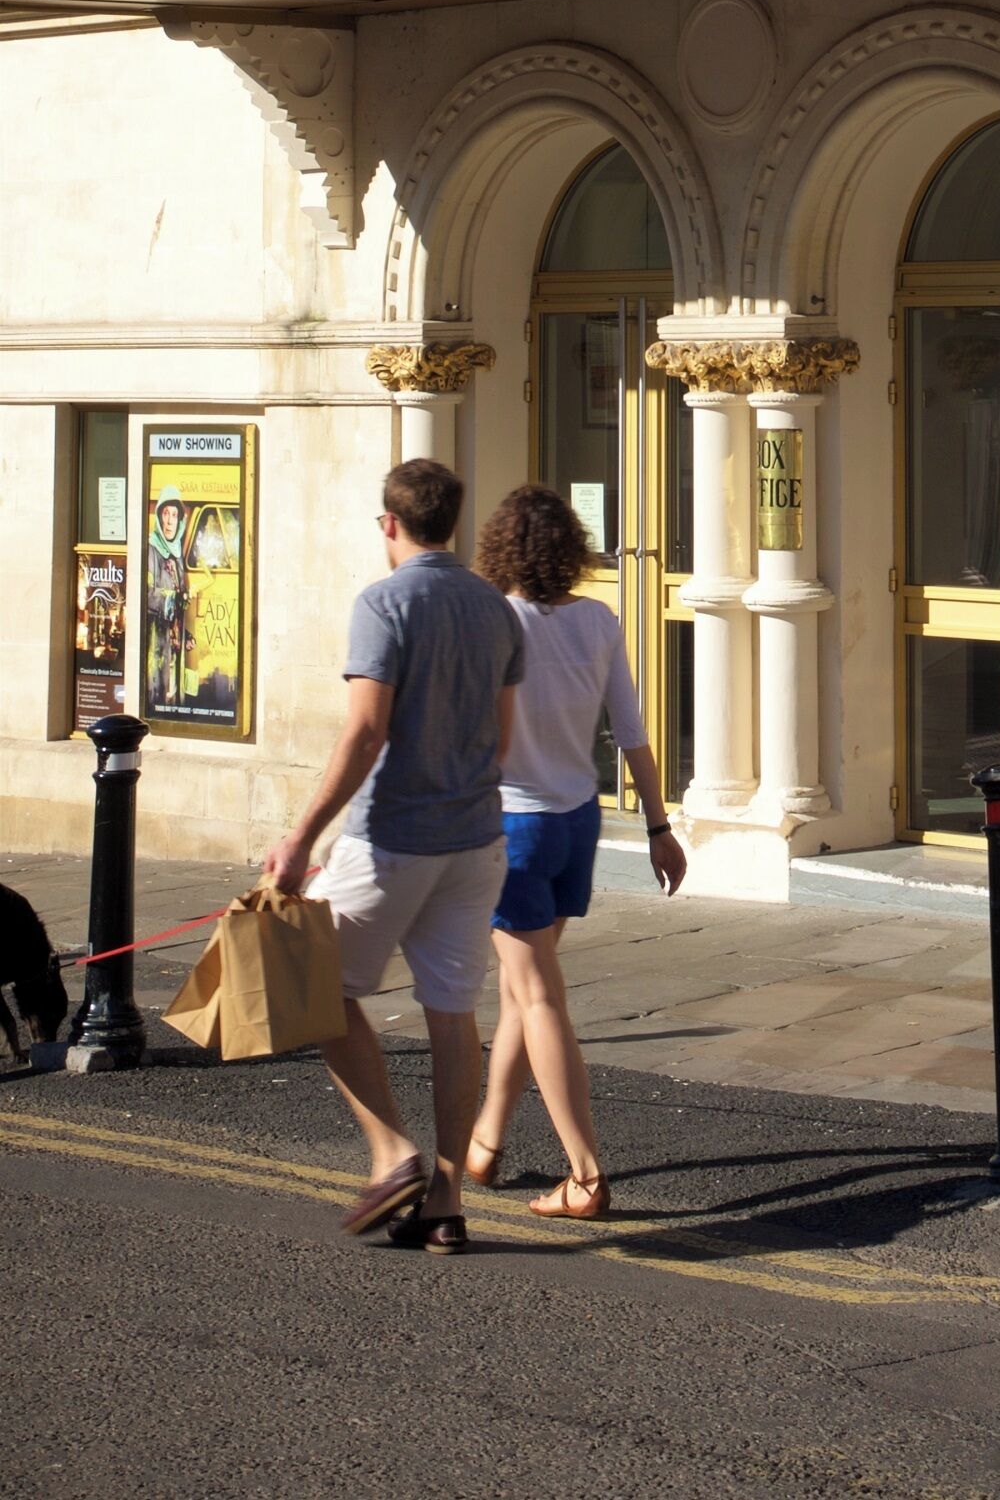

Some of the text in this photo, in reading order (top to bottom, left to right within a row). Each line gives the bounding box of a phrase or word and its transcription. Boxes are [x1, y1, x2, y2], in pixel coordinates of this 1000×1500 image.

[159, 437, 232, 450] NOW SHOWING
[760, 478, 801, 508] FICE
[84, 560, 123, 587] vaults
[196, 592, 236, 628] LADY
[204, 623, 236, 649] VAN
